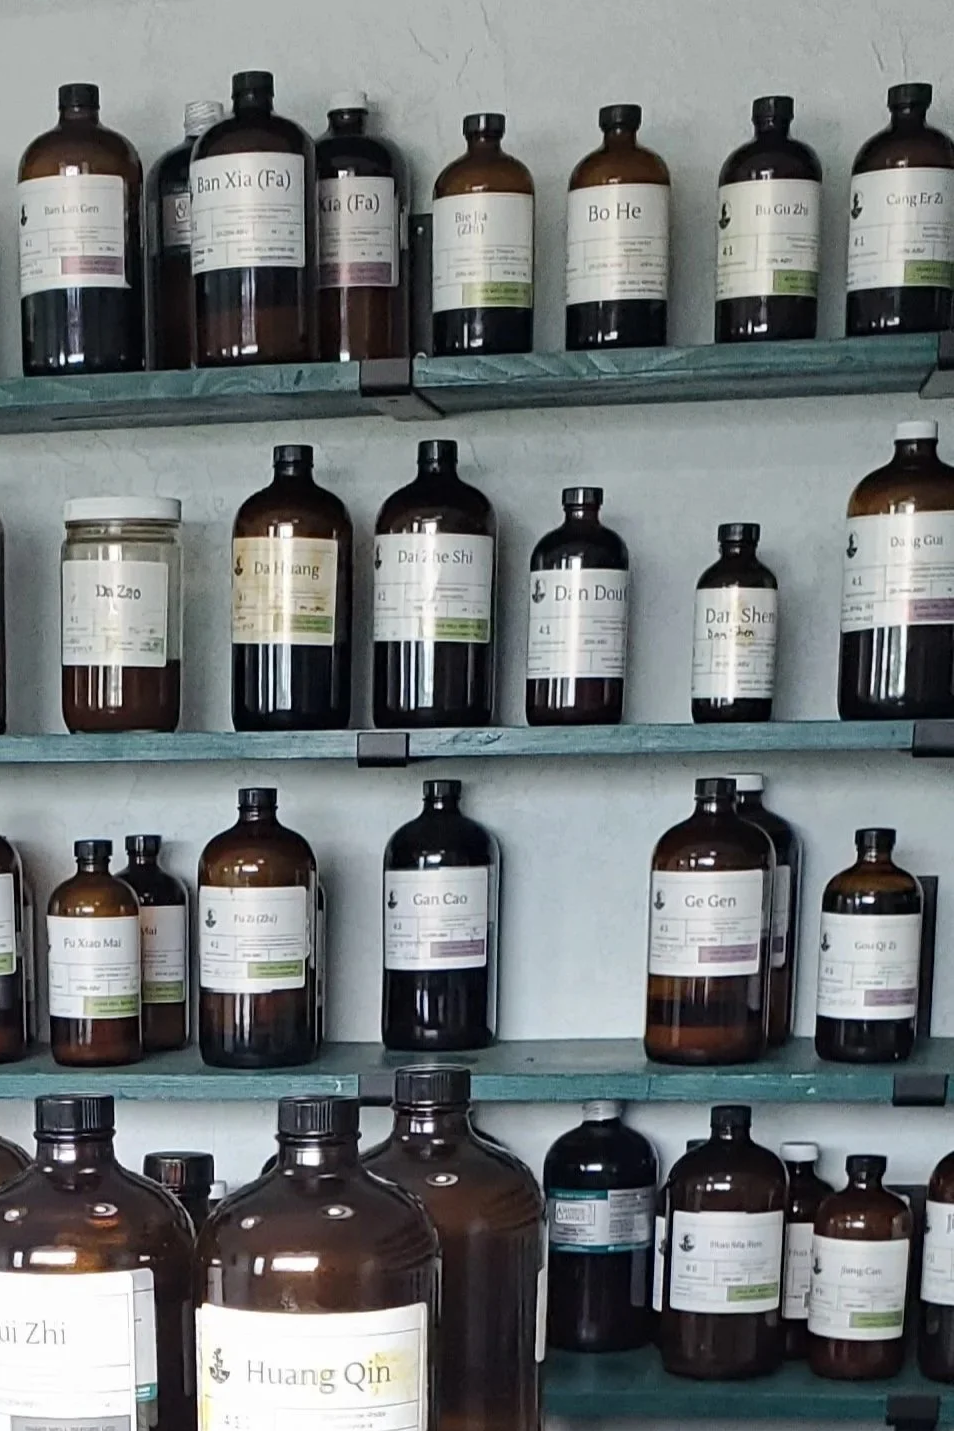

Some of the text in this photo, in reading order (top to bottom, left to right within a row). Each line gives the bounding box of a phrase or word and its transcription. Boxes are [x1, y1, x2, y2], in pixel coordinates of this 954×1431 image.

[197, 169, 292, 194] Ban Xia (Fa)
[346, 192, 381, 214] (Fa)
[886, 193, 917, 208] Cang
[919, 192, 932, 205] Er
[80, 204, 100, 215] Gen
[454, 211, 470, 224] Bie
[588, 202, 642, 223] Bo He
[754, 203, 809, 217] Bu Gu Zhi
[923, 534, 944, 547] Gui
[452, 548, 474, 564] Shi
[253, 560, 320, 580] Da Huang
[95, 583, 142, 600] Da Zao
[741, 606, 775, 624] Shen
[412, 892, 468, 906] Gan Cao
[684, 894, 737, 909] Ge Gen
[233, 912, 278, 926] Fu Zi (Zhi)
[63, 937, 122, 949] Fu Xiao Mai
[854, 940, 875, 951] Gou
[25, 1319, 66, 1346] Zhi
[246, 1358, 392, 1395] Huang Qin
